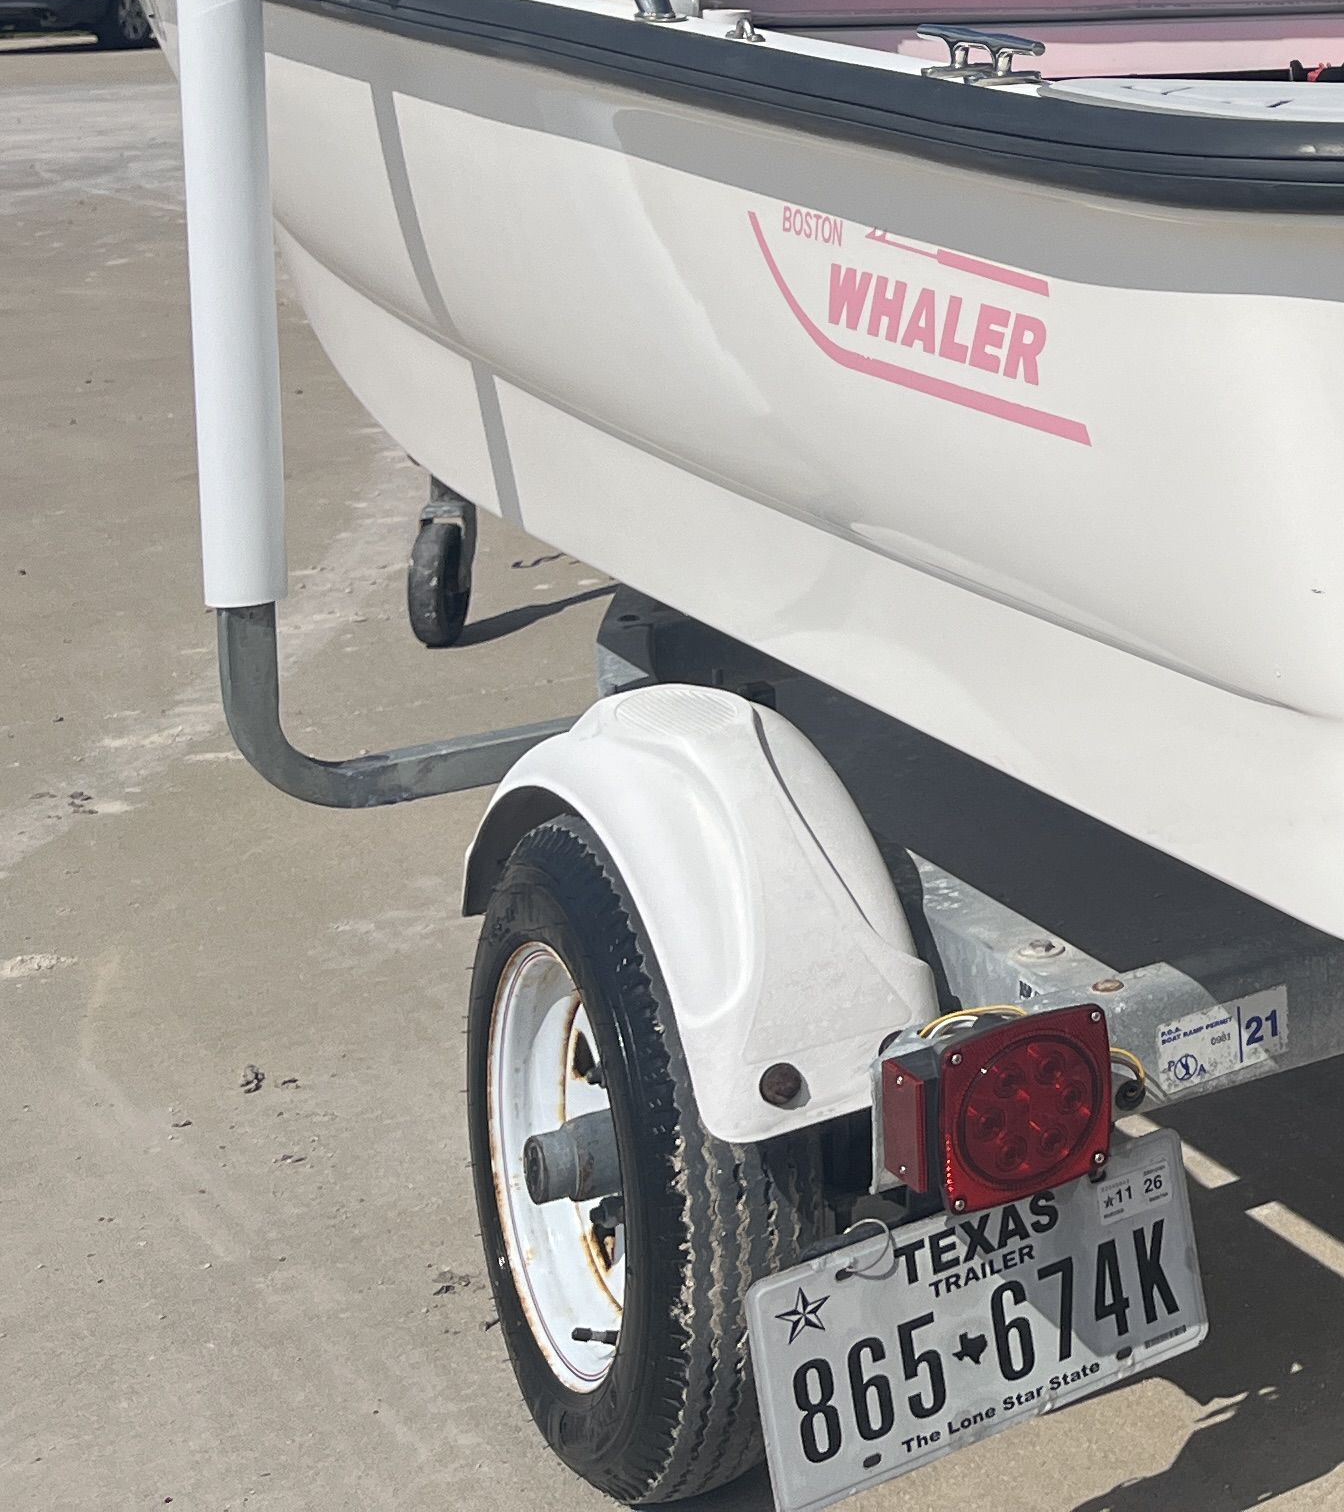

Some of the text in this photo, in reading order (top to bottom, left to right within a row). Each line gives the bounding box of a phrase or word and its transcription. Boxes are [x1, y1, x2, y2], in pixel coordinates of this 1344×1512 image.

[782, 206, 843, 247] BOSTON
[828, 263, 1047, 386] WHALER
[1245, 1009, 1279, 1046] 21
[1116, 1185, 1132, 1203] 11
[1143, 1175, 1163, 1193] 26
[894, 1191, 1059, 1285] TEXAS
[928, 1245, 1036, 1299] TRAILER
[901, 1361, 1101, 1454] The Lone Star State
